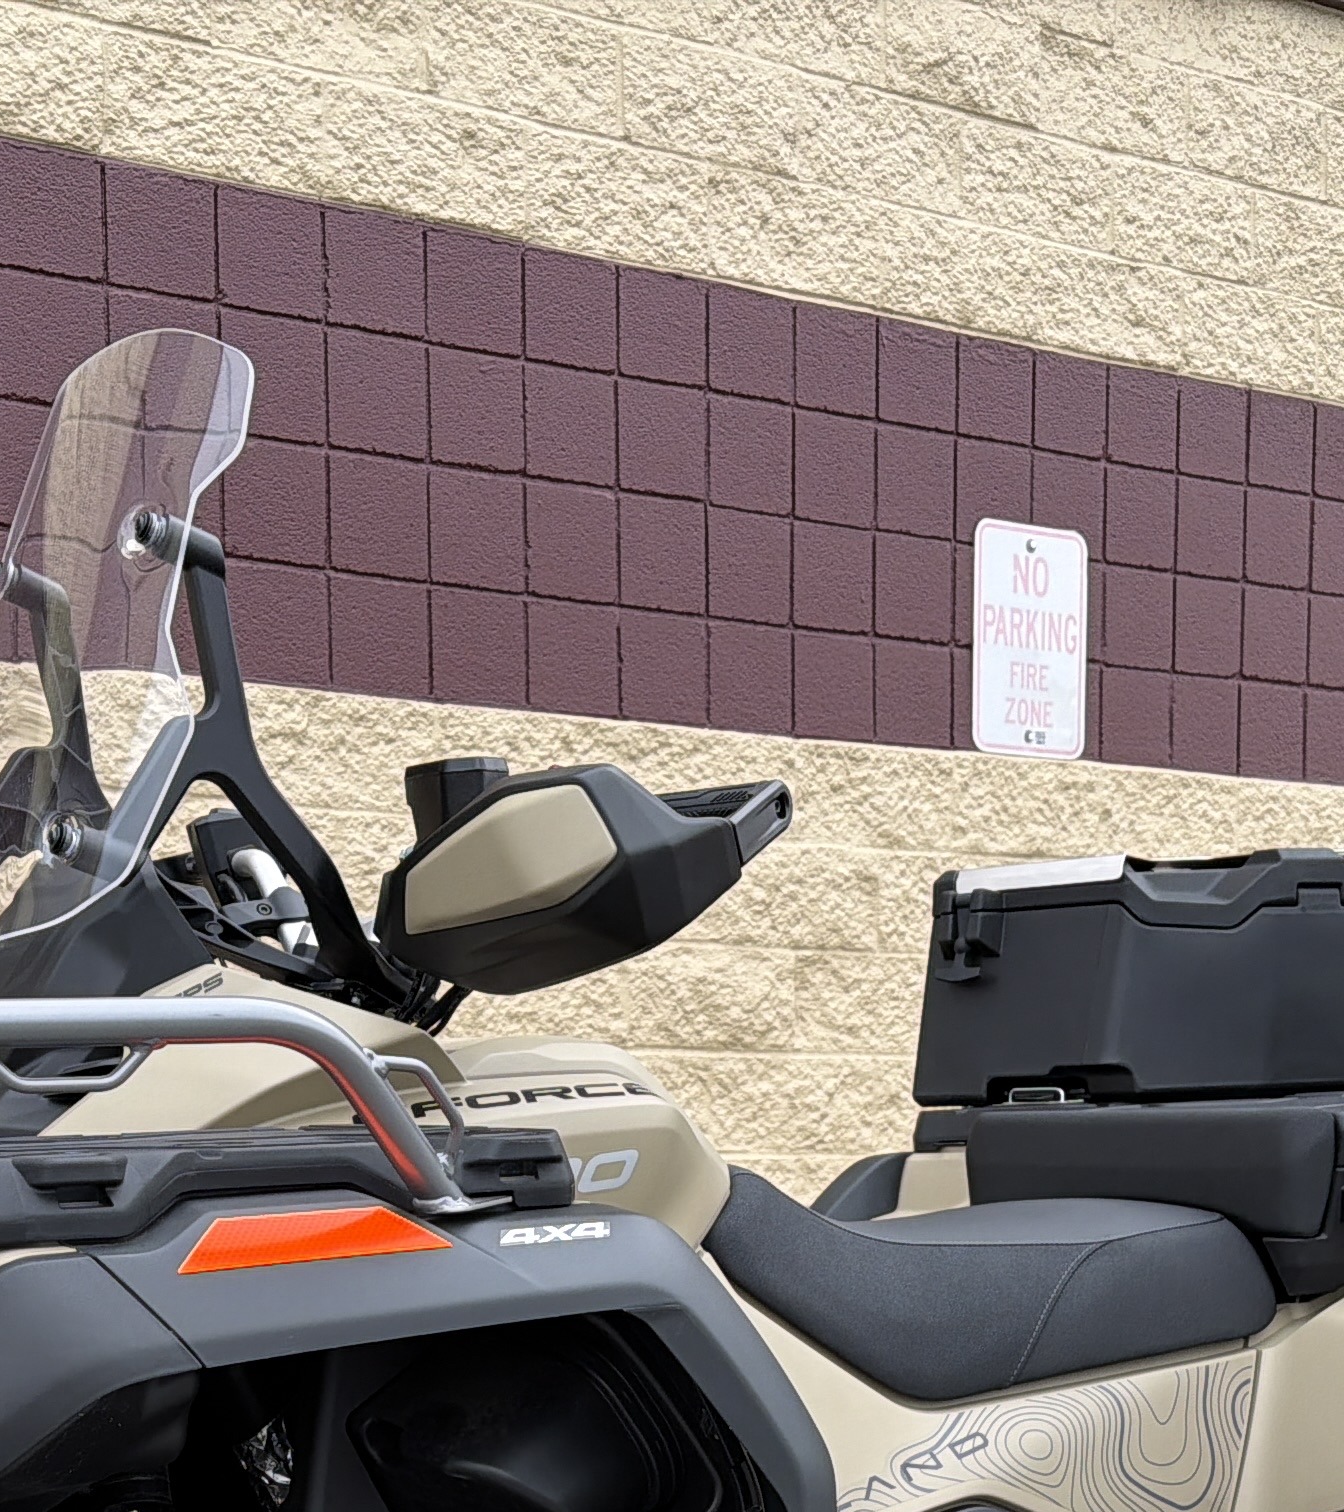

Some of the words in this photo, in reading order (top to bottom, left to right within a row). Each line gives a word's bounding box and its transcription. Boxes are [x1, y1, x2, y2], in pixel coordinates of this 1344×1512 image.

[1012, 554, 1050, 598] NO
[983, 604, 1078, 655] PARKING
[1009, 661, 1049, 692] FIRE
[1004, 697, 1054, 728] ZONE
[500, 1221, 611, 1246] 4X4
